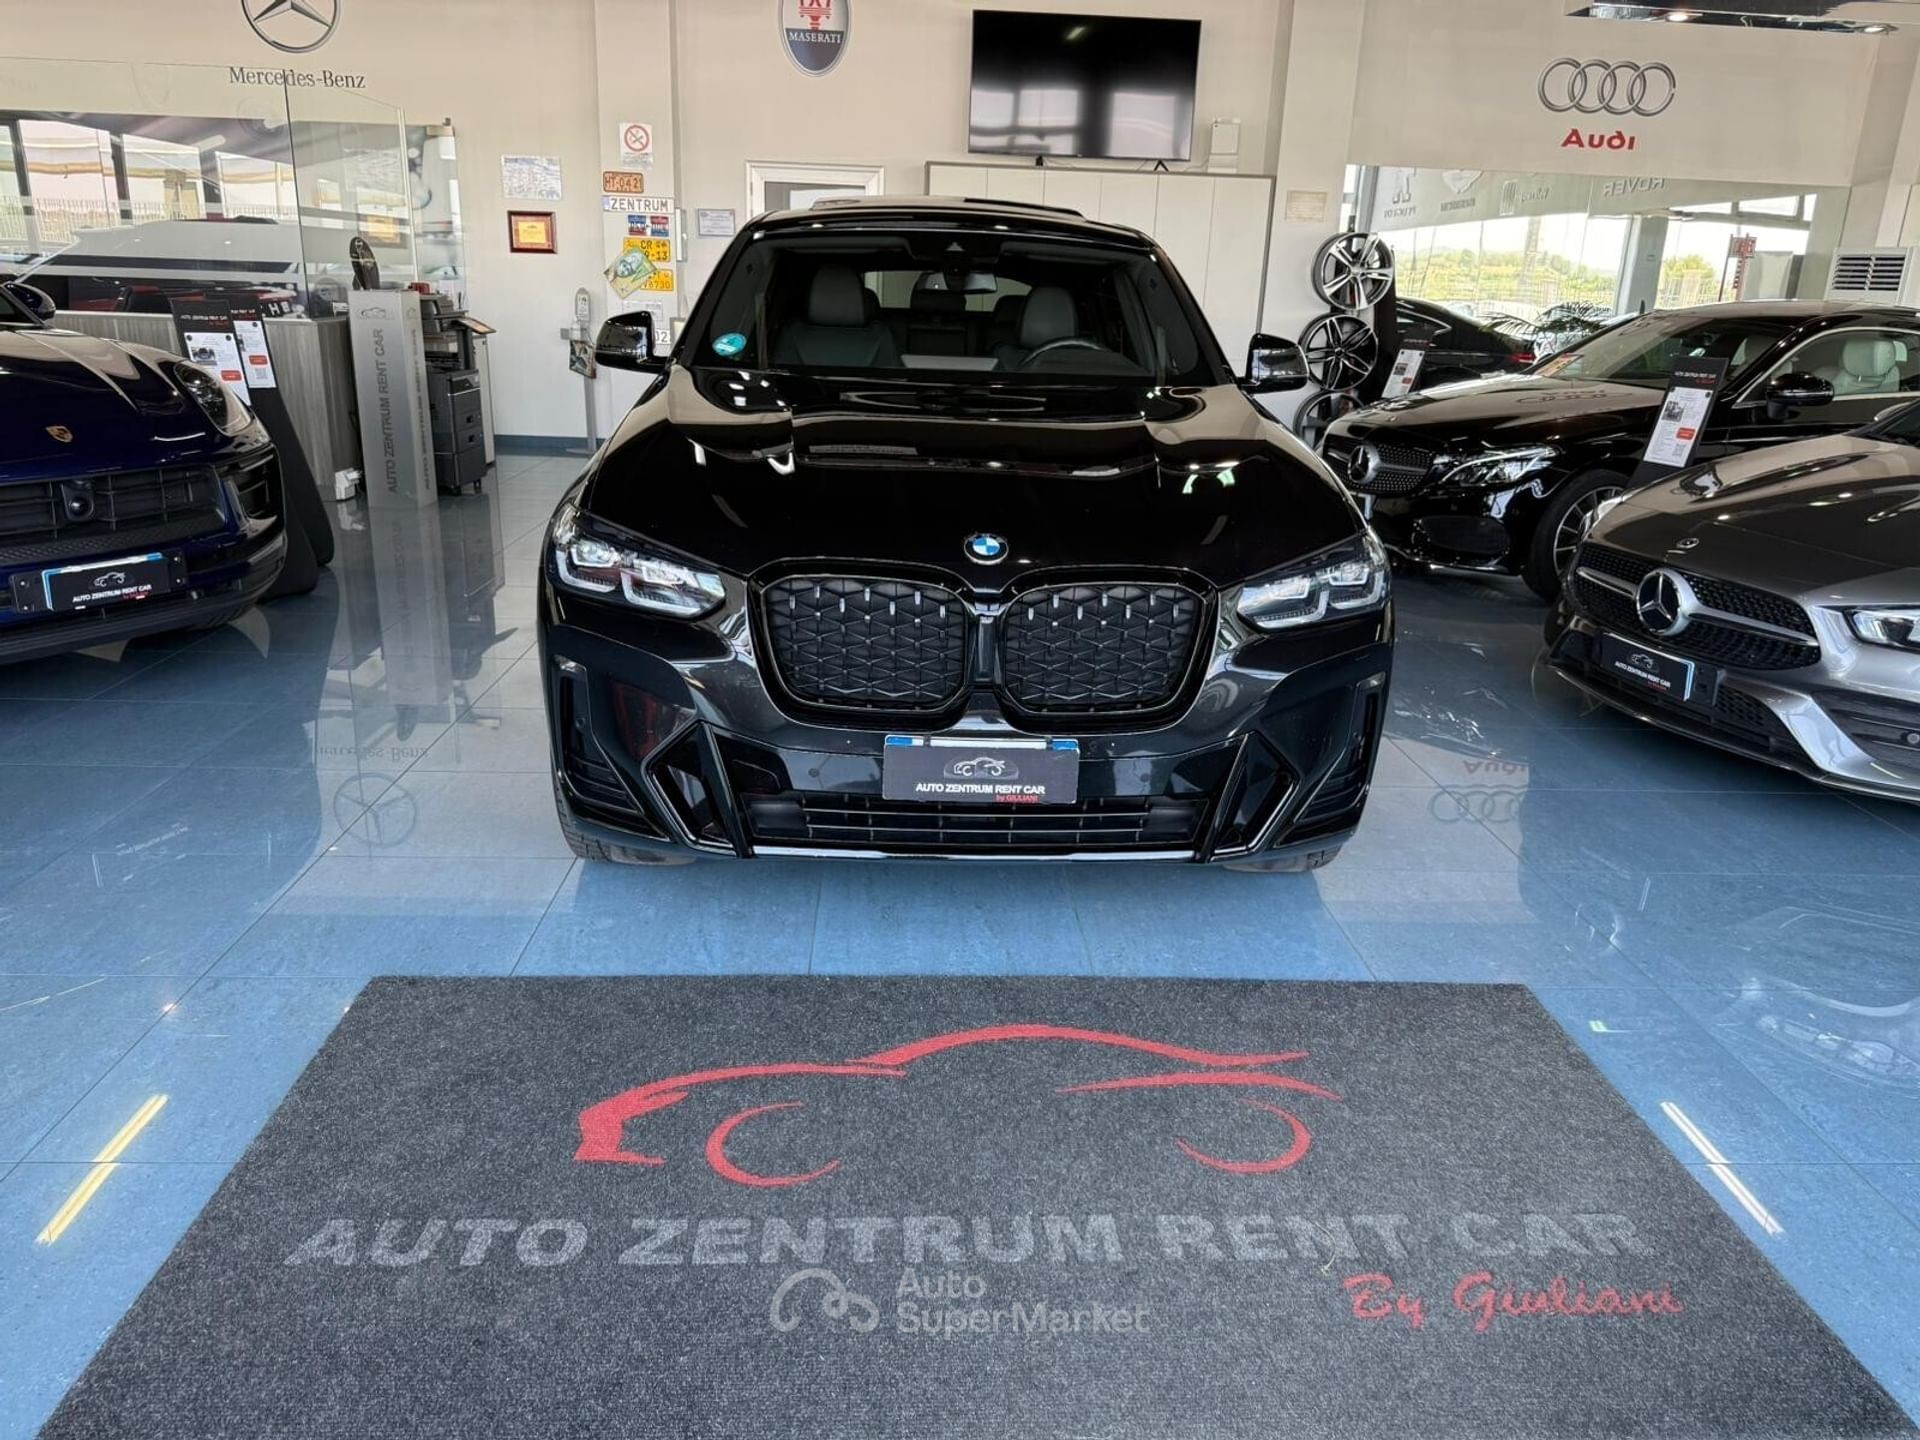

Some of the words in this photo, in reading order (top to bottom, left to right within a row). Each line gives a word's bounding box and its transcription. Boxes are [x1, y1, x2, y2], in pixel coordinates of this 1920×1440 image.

[789, 32, 841, 43] MASERATI
[229, 66, 366, 89] Mercedes-Benz
[1561, 128, 1635, 150] Audi
[611, 198, 669, 212] ZENTRUM
[372, 328, 385, 357] CAR
[375, 359, 389, 394] RENT
[378, 397, 395, 457] ZENTRUM
[384, 460, 398, 494] AUTO
[72, 593, 91, 603] AUTO
[91, 589, 121, 600] ZENTRUM
[122, 585, 138, 594] RENT
[138, 583, 152, 592] CAR
[915, 783, 944, 793] AUTO
[945, 783, 994, 795] ZENTRUM
[995, 784, 1023, 795] RENT
[1023, 785, 1046, 795] CAR
[283, 1218, 589, 1267] AUTO
[617, 1213, 1125, 1265] ZENTRUM
[1155, 1213, 1410, 1260] RENT
[1451, 1211, 1656, 1258] CAR
[1343, 1272, 1427, 1329] By
[1453, 1270, 1685, 1333] Giuliani
